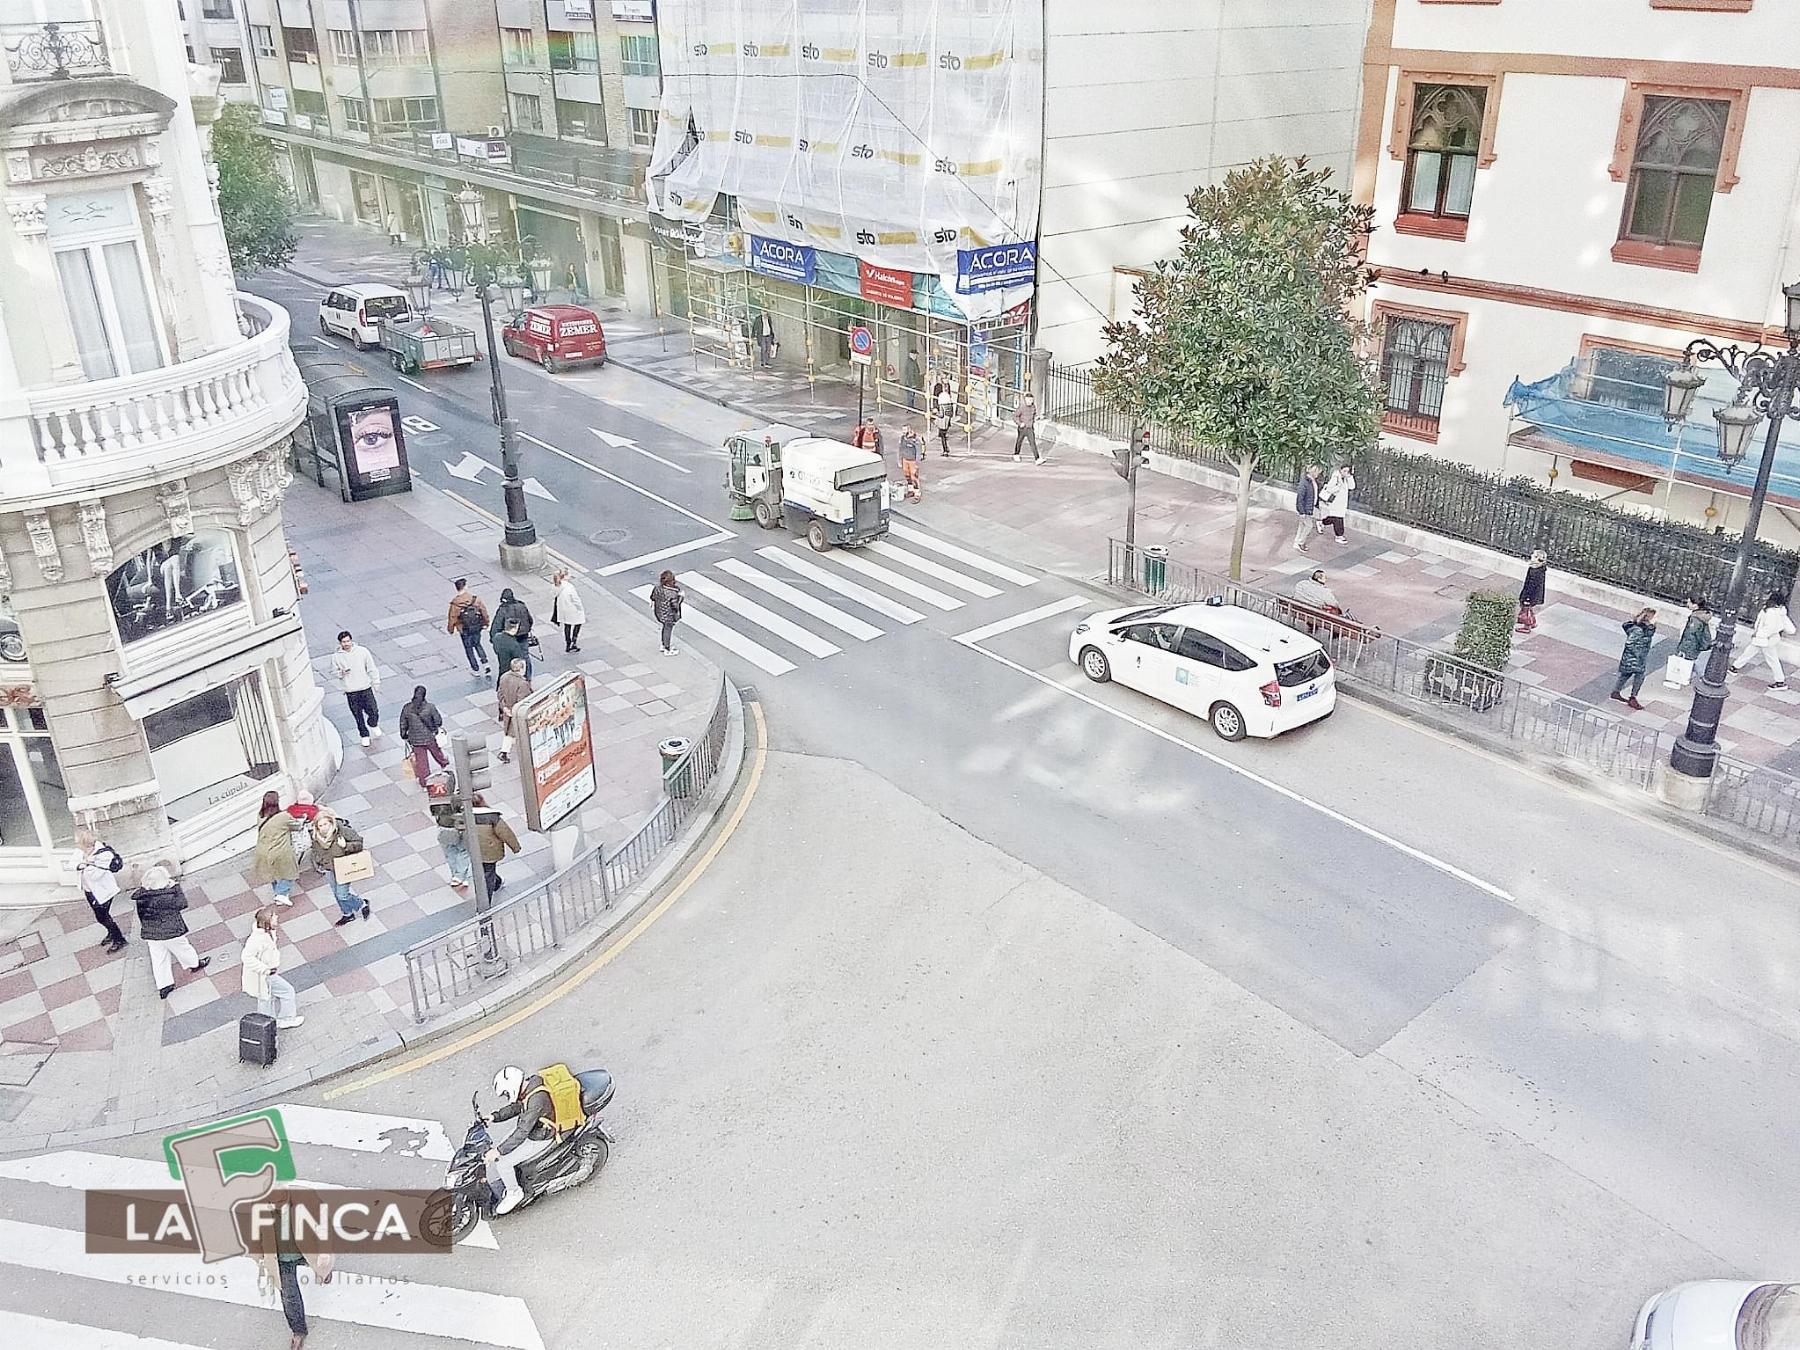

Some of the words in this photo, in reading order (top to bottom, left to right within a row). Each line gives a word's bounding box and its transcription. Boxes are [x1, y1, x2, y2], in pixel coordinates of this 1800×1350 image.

[743, 41, 759, 57] sto
[802, 42, 820, 60] sto
[868, 49, 888, 69] sto
[939, 50, 961, 70] sto
[734, 129, 753, 145] sto
[851, 144, 874, 159] sto
[857, 228, 876, 245] sto
[934, 227, 957, 243] sto
[759, 240, 805, 266] ACORA
[969, 247, 1035, 273] ACORA
[560, 324, 598, 337] ZEMER
[208, 796, 220, 805] La
[221, 782, 248, 798] cúpula
